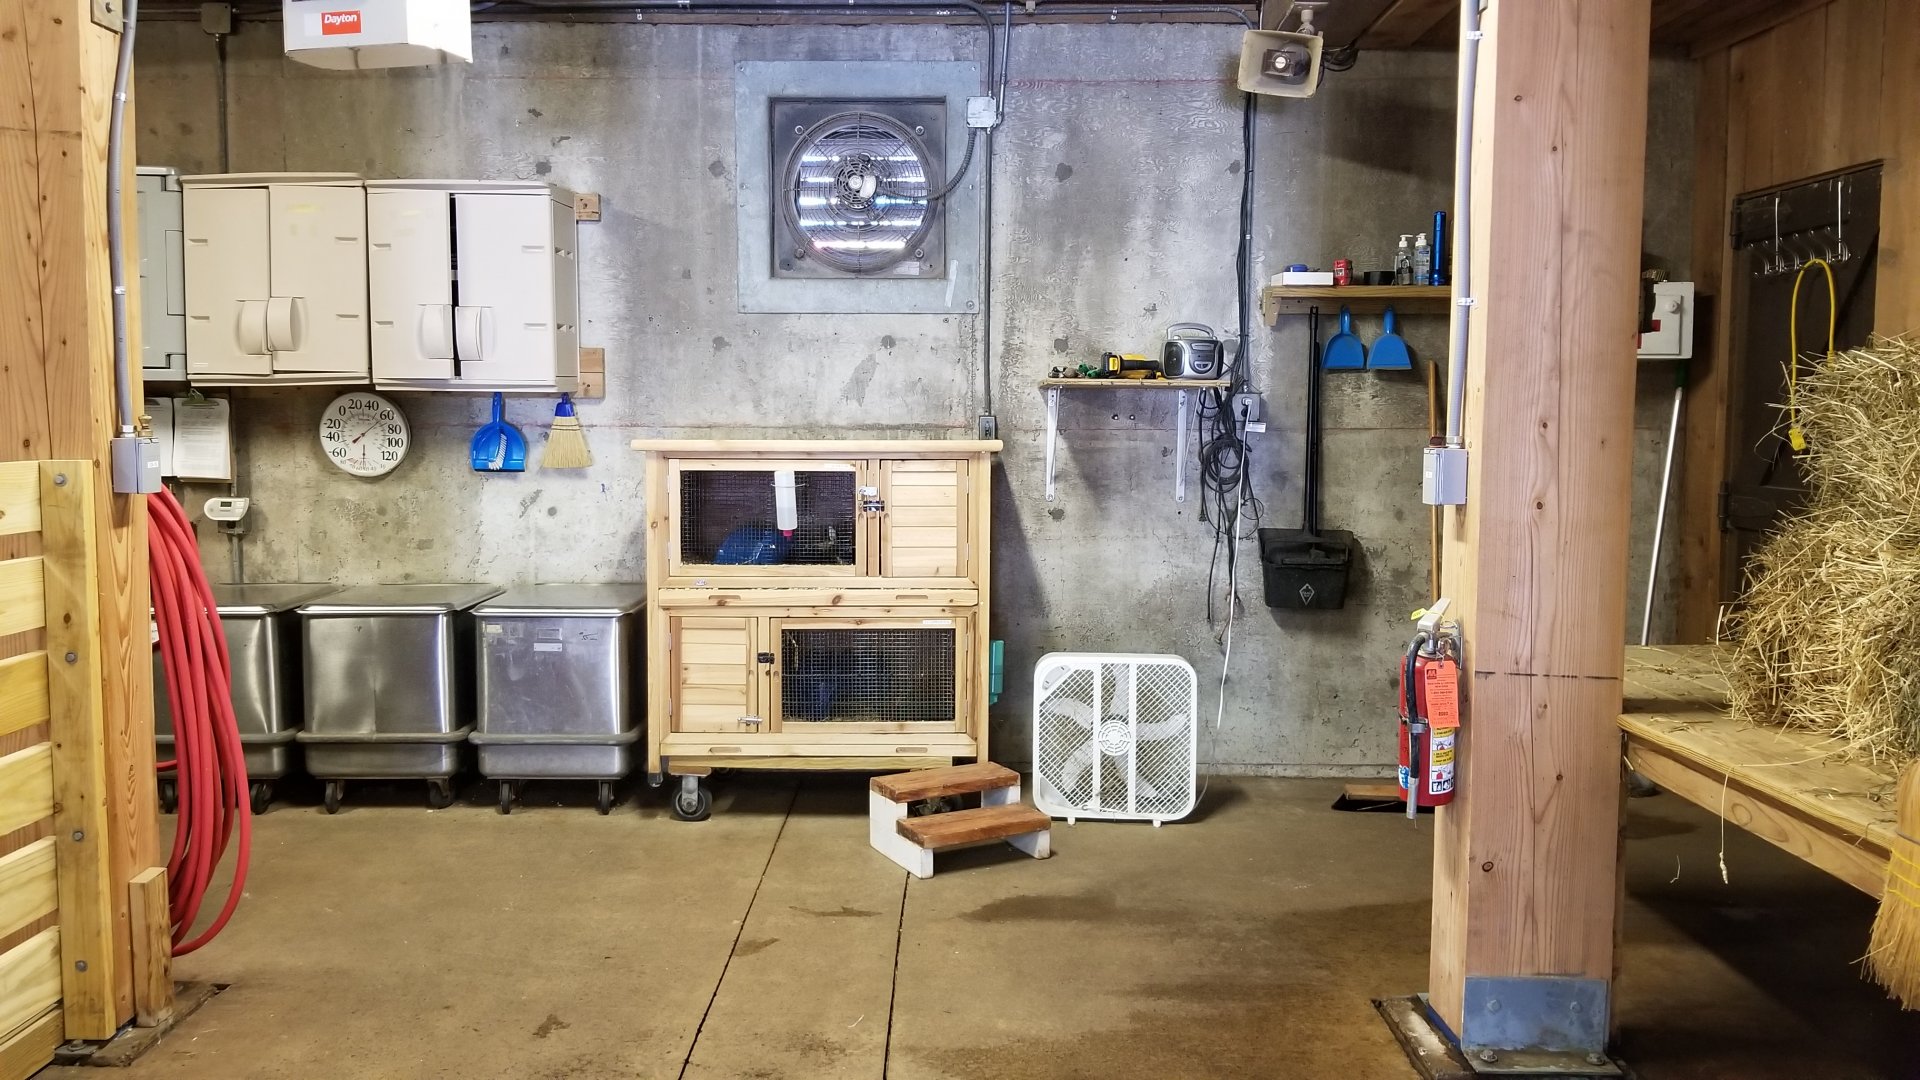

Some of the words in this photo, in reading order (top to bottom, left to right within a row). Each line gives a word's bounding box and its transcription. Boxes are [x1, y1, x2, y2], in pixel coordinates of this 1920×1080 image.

[324, 13, 358, 26] Dayton
[347, 398, 363, 410] 20
[364, 399, 380, 411] 40
[338, 405, 346, 416] 0
[379, 409, 395, 421] 60
[323, 418, 341, 429] -20
[387, 423, 402, 435] 80
[322, 431, 340, 442] -40
[387, 437, 404, 448] 100
[328, 447, 347, 458] -60
[381, 450, 398, 461] 120
